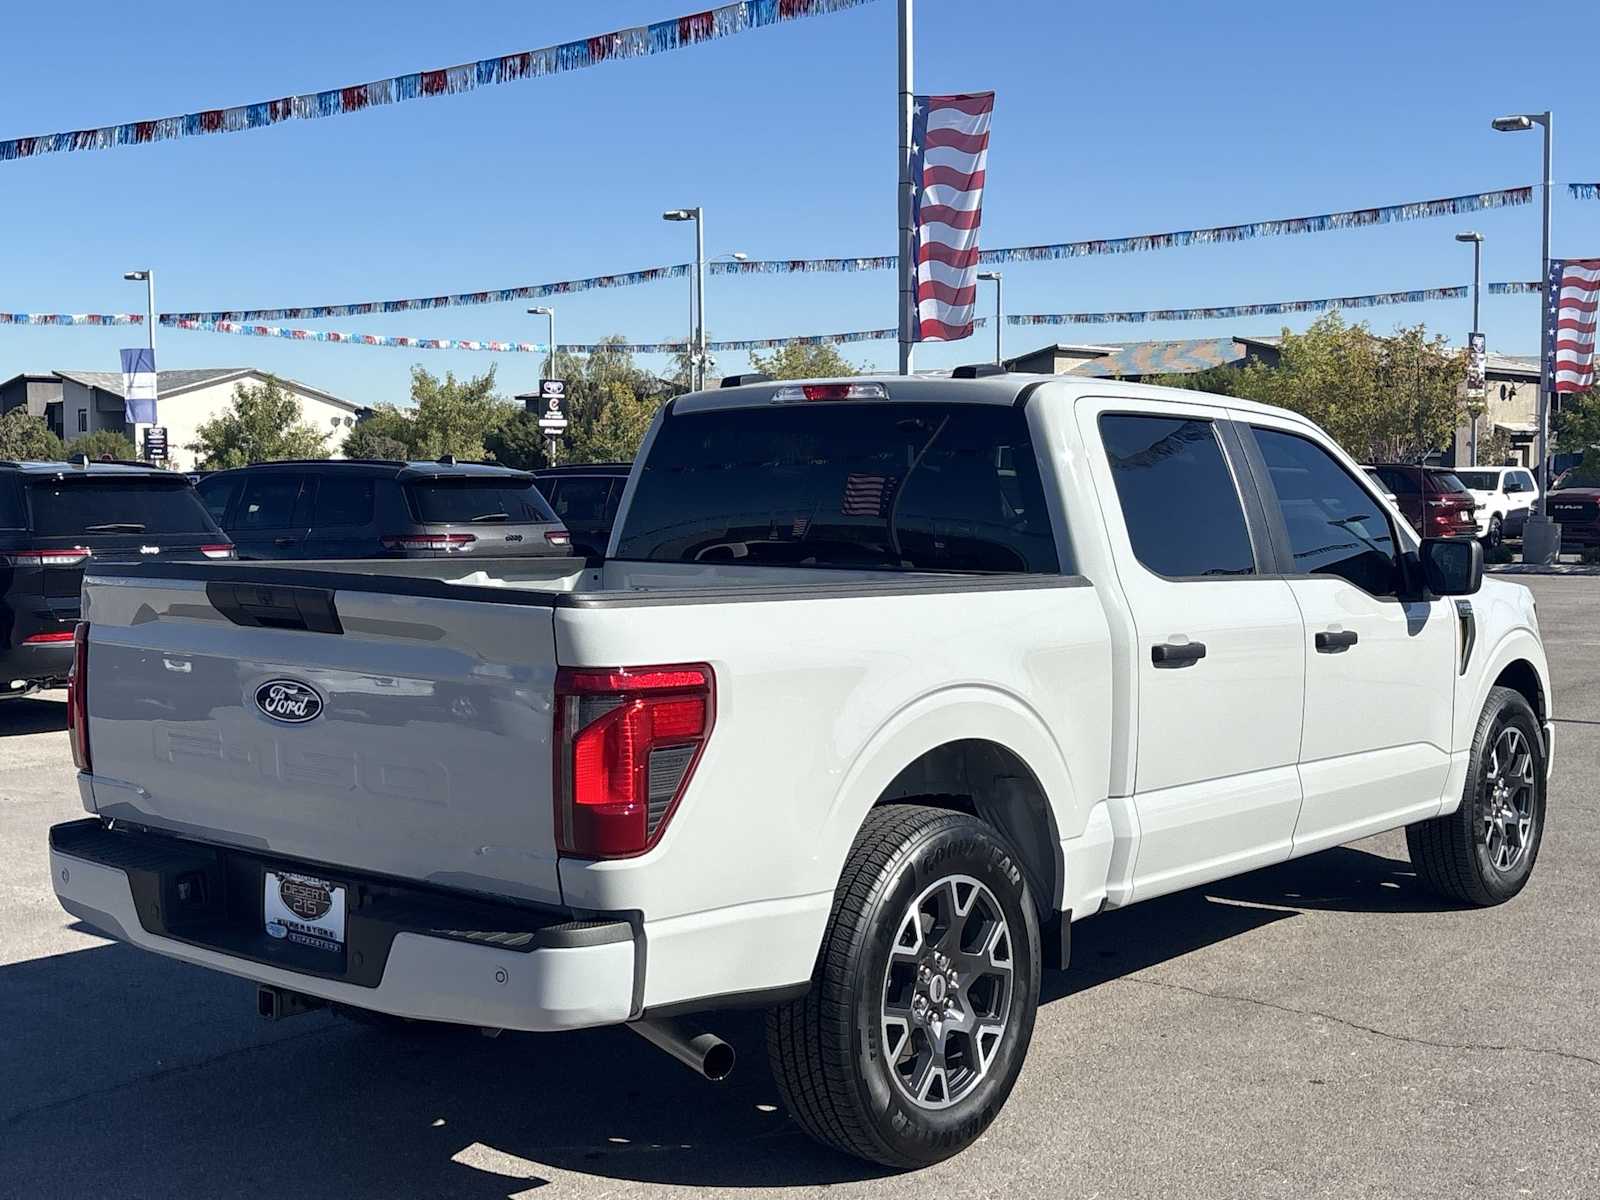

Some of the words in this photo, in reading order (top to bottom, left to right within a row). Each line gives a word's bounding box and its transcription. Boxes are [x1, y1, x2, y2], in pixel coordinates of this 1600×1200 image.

[140, 545, 160, 554] Jeep
[265, 685, 309, 716] Ford
[284, 882, 327, 901] DESERT
[294, 898, 317, 914] 215
